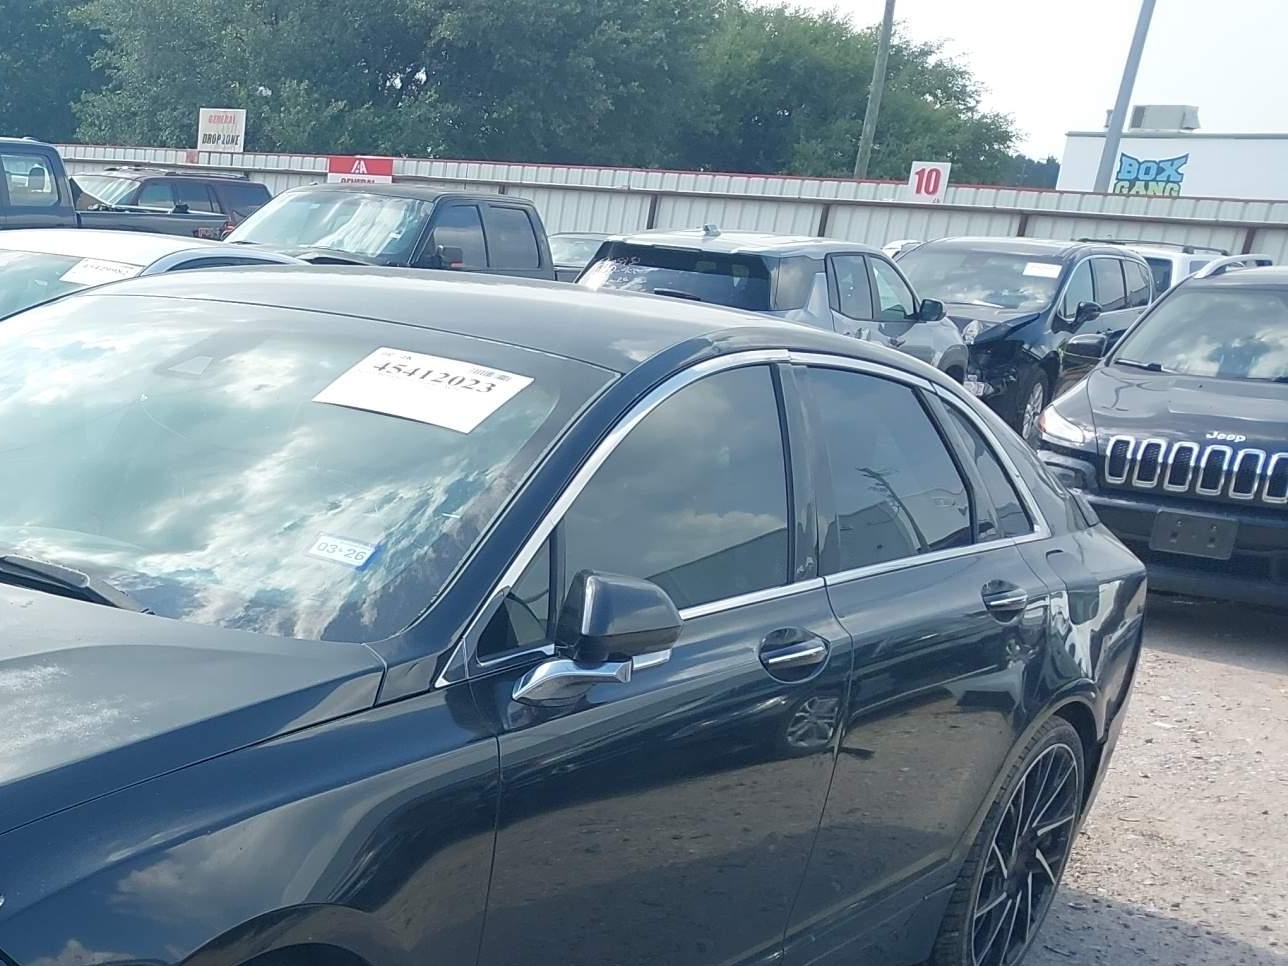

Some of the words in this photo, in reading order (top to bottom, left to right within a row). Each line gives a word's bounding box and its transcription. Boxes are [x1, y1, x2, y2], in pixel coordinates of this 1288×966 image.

[202, 133, 222, 145] DROP
[222, 134, 241, 146] ZONE
[1116, 152, 1189, 183] BOX
[915, 168, 942, 195] 10
[373, 361, 497, 393] 45412023
[1205, 431, 1247, 443] Jeep
